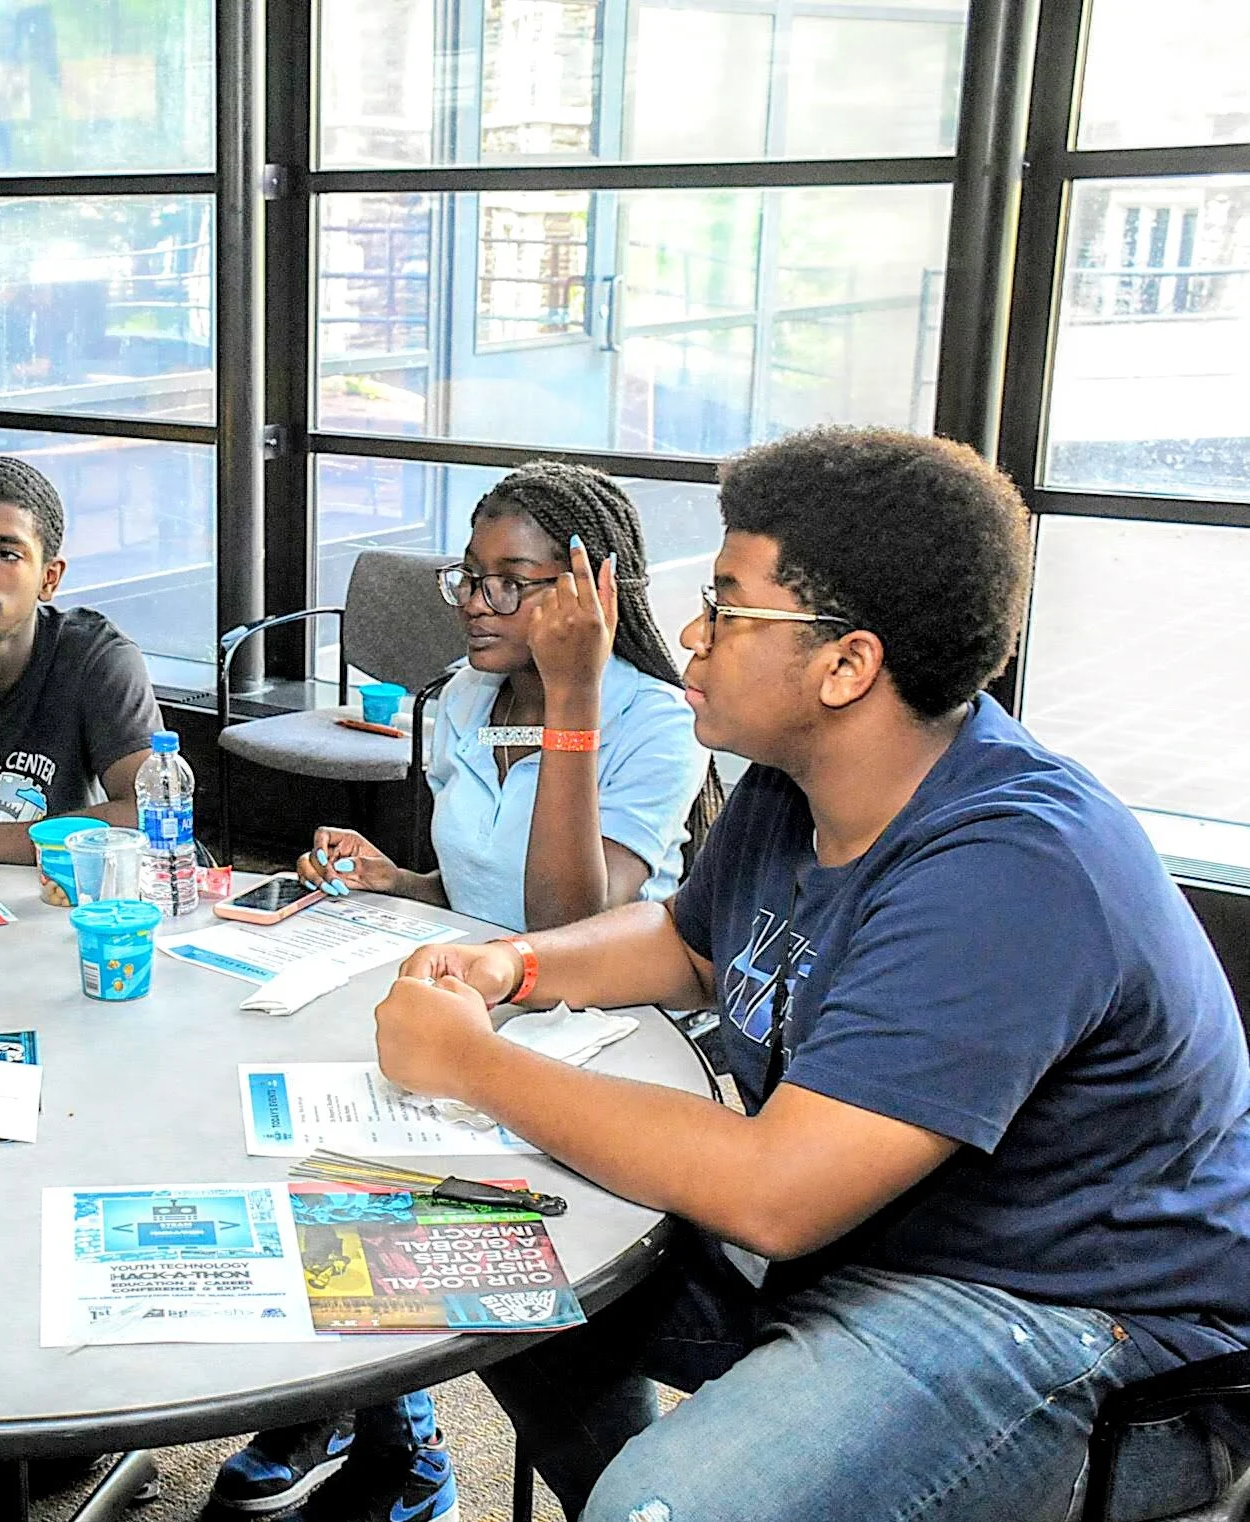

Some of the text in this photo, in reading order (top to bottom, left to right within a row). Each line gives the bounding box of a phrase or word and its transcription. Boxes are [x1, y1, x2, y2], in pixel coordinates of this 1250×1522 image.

[5, 751, 56, 786] CENTER
[428, 1225, 533, 1239] IMPACT
[395, 1236, 537, 1253] A GLOBAL
[414, 1248, 543, 1264] CREATES
[110, 1262, 250, 1272] YOUTH TECHNOLOGY
[421, 1260, 549, 1277] HISTORY
[110, 1270, 250, 1282] HACK-A-THON
[382, 1271, 553, 1290] OUR LOCAL
[111, 1286, 197, 1294] CONFERENCE
